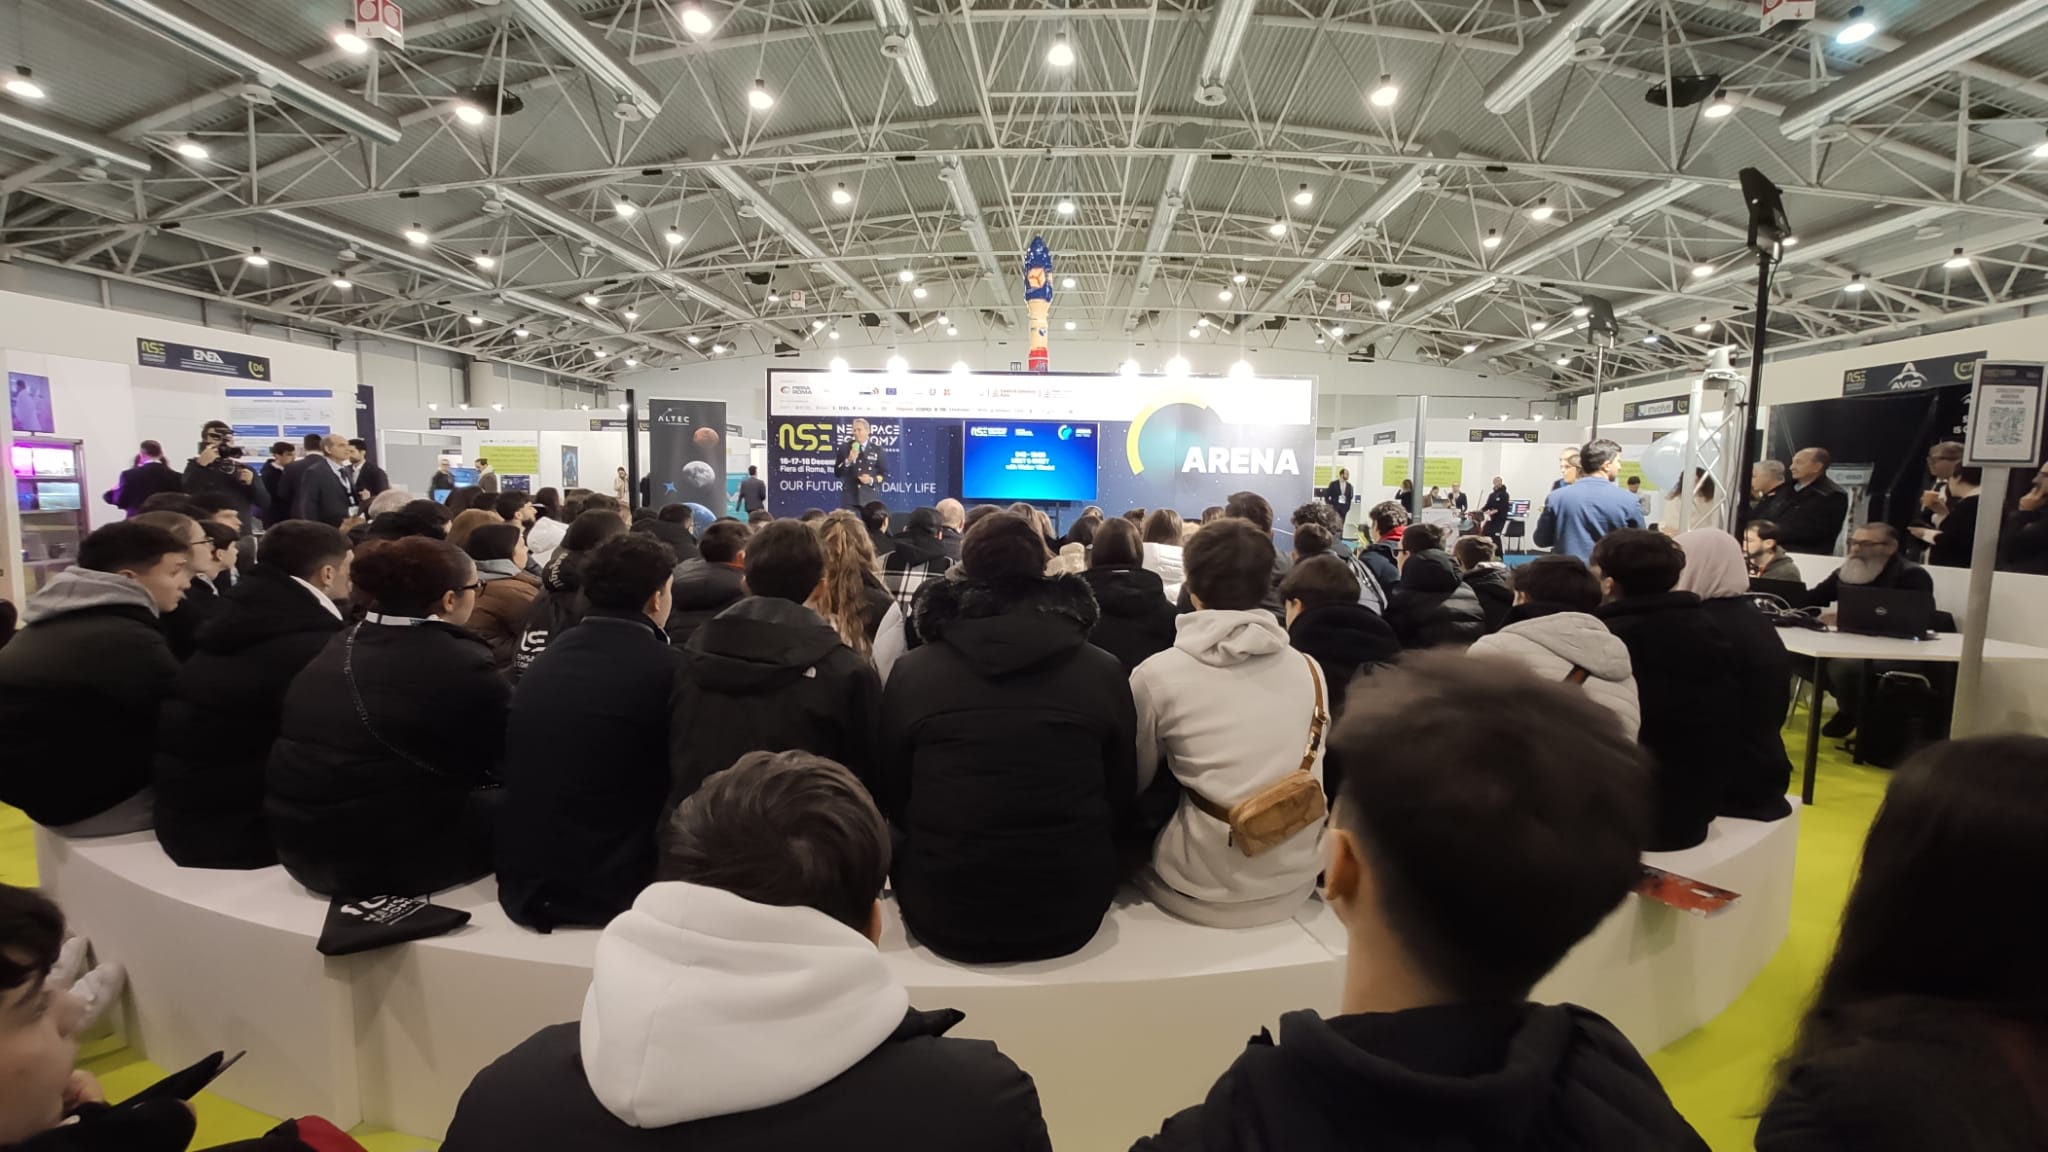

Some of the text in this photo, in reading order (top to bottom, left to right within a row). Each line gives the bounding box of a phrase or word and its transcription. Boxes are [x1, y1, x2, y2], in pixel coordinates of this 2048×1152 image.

[193, 349, 225, 364] ENEA
[1891, 379, 1921, 391] AVIO
[657, 415, 690, 424] ALTEC
[837, 424, 900, 435] NE PACE
[779, 423, 833, 451] NSE
[811, 457, 837, 466] Decem
[1181, 446, 1300, 476] ARENA
[780, 465, 797, 473] Fiera
[797, 465, 805, 473] di
[780, 480, 844, 492] OUR FUTUR
[882, 482, 937, 494] DAILY LIFE
